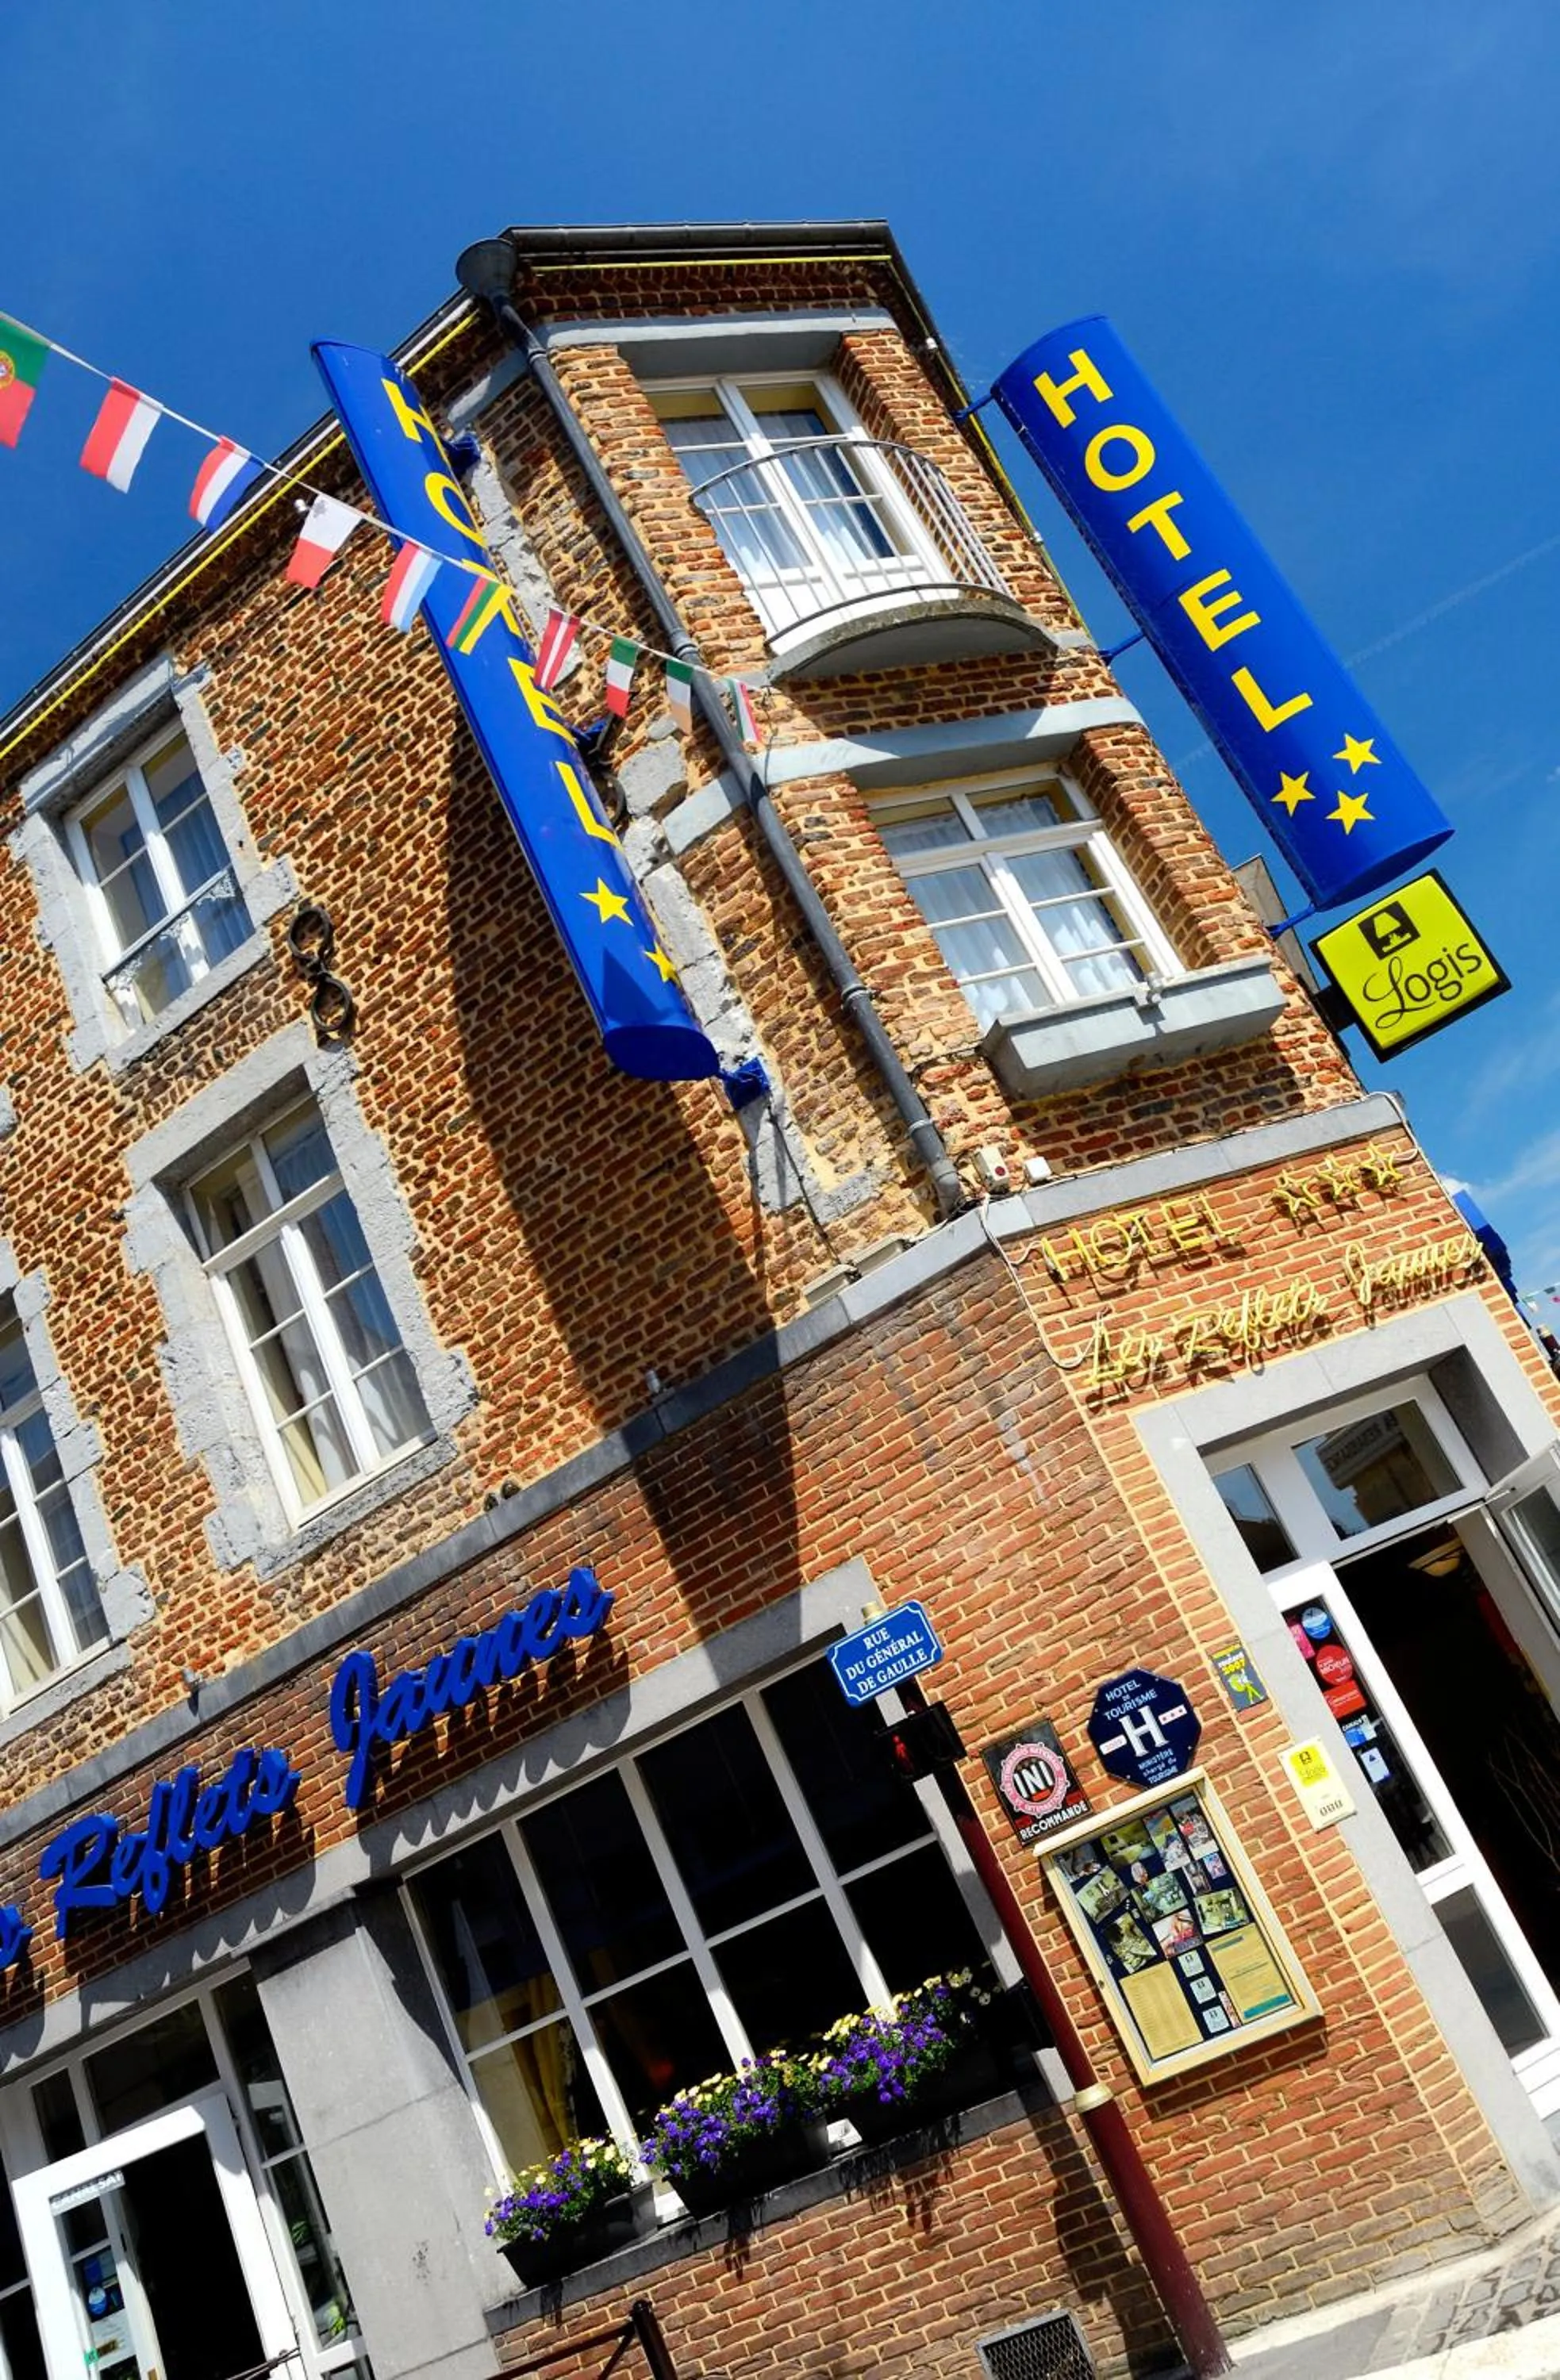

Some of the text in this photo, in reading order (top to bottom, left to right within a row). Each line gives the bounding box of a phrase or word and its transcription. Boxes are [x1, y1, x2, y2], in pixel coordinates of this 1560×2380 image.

[1034, 347, 1314, 733] HOTEL
[1362, 942, 1484, 1030] Logis
[1040, 1192, 1245, 1282] HOTEL
[1173, 1276, 1330, 1363] Reflets
[1345, 1231, 1483, 1304] Jaunes
[846, 1631, 924, 1680] DU GÉNÉRAL
[863, 1628, 890, 1650] RUE
[857, 1649, 927, 1695] DE GAULLE
[1105, 1679, 1141, 1702] HOTEL
[1104, 1688, 1158, 1721] TOURISME
[40, 1749, 302, 1938] Reflets
[330, 1567, 614, 1809] Jaunes
[1119, 1705, 1170, 1757] H
[1014, 1760, 1054, 1799] INI
